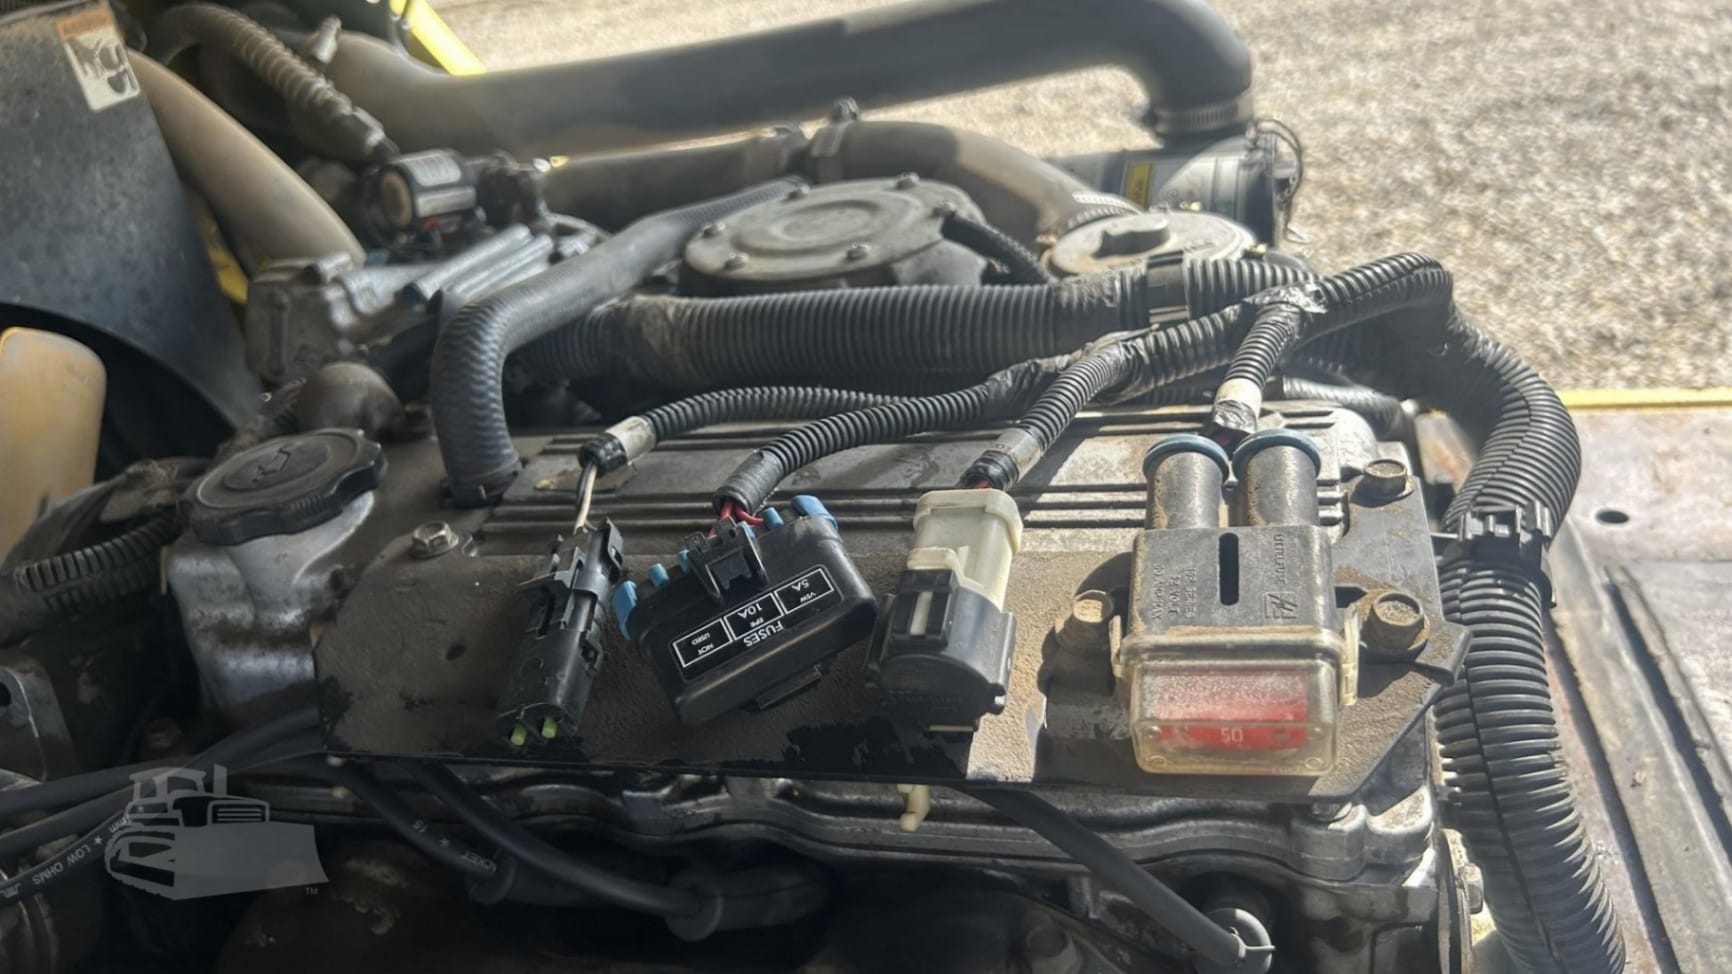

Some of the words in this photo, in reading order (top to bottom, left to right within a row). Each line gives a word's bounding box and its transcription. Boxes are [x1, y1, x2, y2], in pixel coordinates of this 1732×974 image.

[791, 579, 809, 592] 5A
[737, 603, 762, 619] 10A
[691, 633, 711, 645] USED
[743, 621, 784, 647] FUSES
[698, 643, 714, 655] NOT
[1221, 728, 1243, 743] 50
[66, 844, 91, 866] LOW
[32, 862, 64, 885] OHMS
